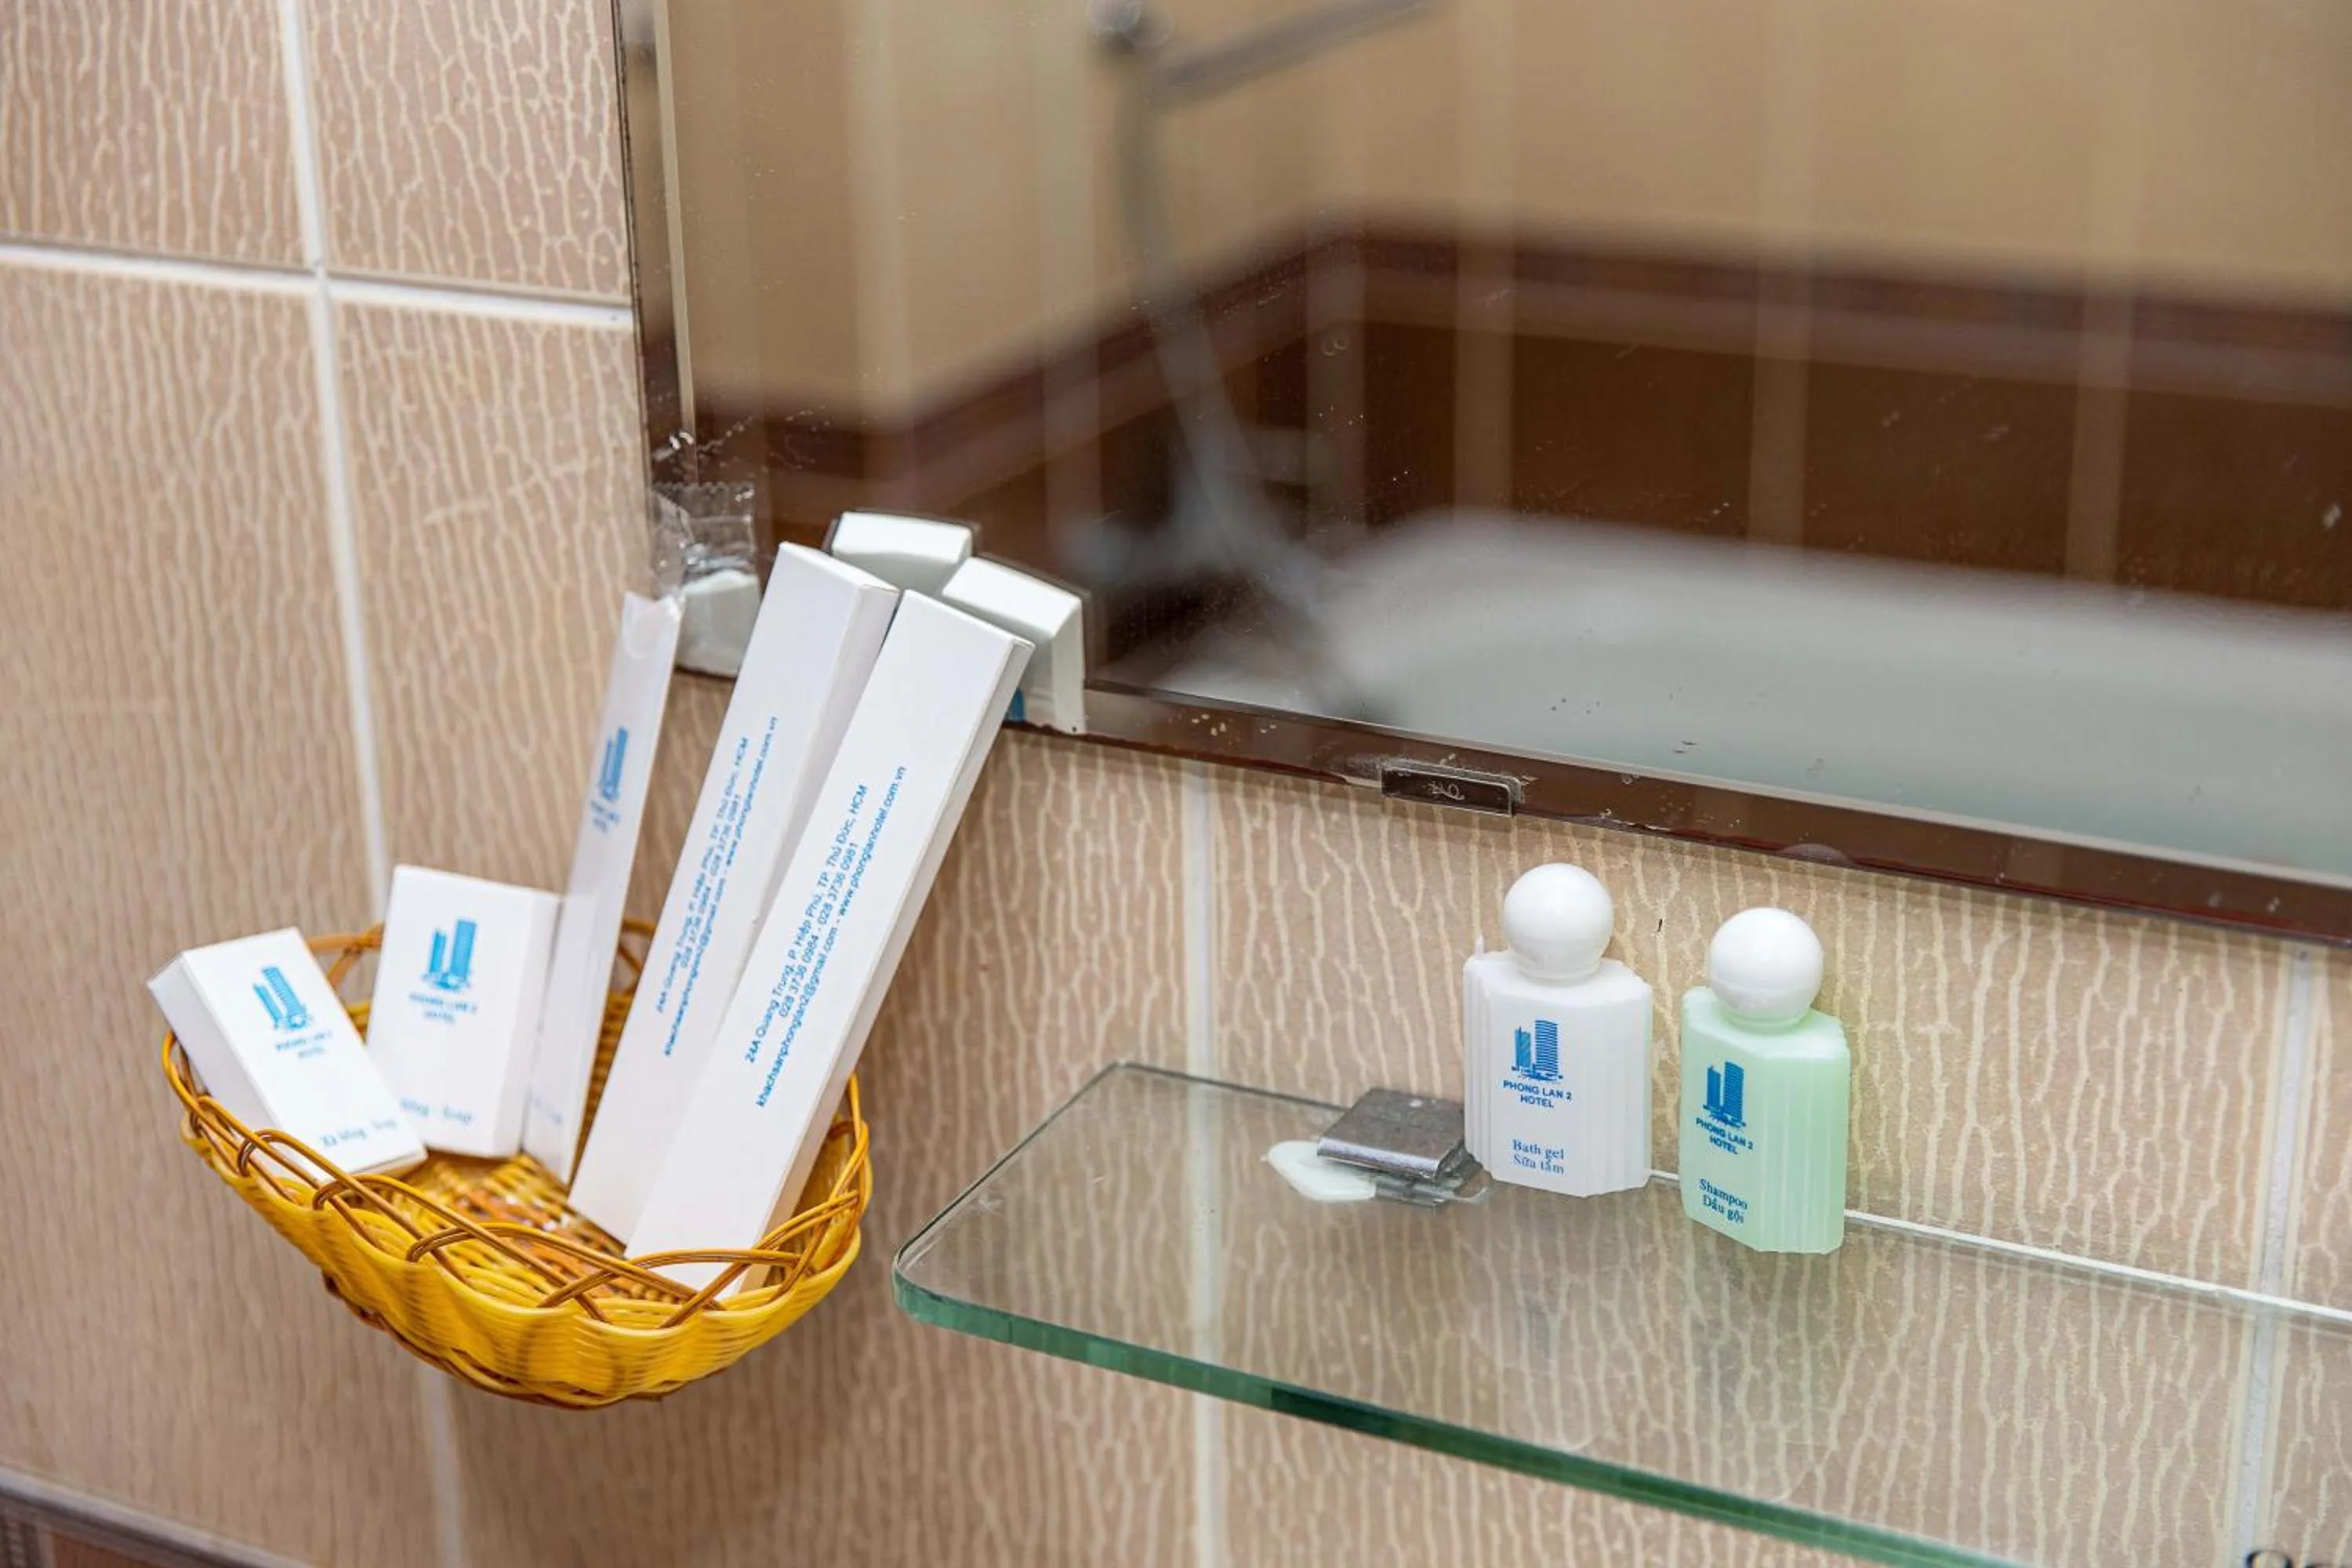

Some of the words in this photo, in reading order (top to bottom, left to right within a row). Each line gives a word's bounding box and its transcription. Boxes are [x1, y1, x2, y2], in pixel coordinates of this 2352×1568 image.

[837, 764, 906, 916] www.phonglanhotel.com.vn
[743, 1038, 762, 1064] 24A
[753, 997, 780, 1039] Quang
[847, 782, 869, 815] HCM
[777, 994, 795, 1018] 028
[786, 963, 808, 994] 3736
[815, 901, 833, 926] 028
[1503, 1080, 1540, 1095] PHONG
[1542, 1087, 1564, 1099] LAN
[1566, 1091, 1573, 1101] 2
[1519, 1094, 1555, 1109] HOTEL
[1696, 1117, 1726, 1138] PHONG
[1728, 1131, 1746, 1148] LAN
[1512, 1138, 1541, 1156] Bath
[1545, 1148, 1564, 1160] gel
[1709, 1134, 1738, 1155] HOTEL
[1513, 1153, 1537, 1169] Sữa
[1699, 1178, 1748, 1210] Shampoo
[1703, 1194, 1725, 1214] Dầu
